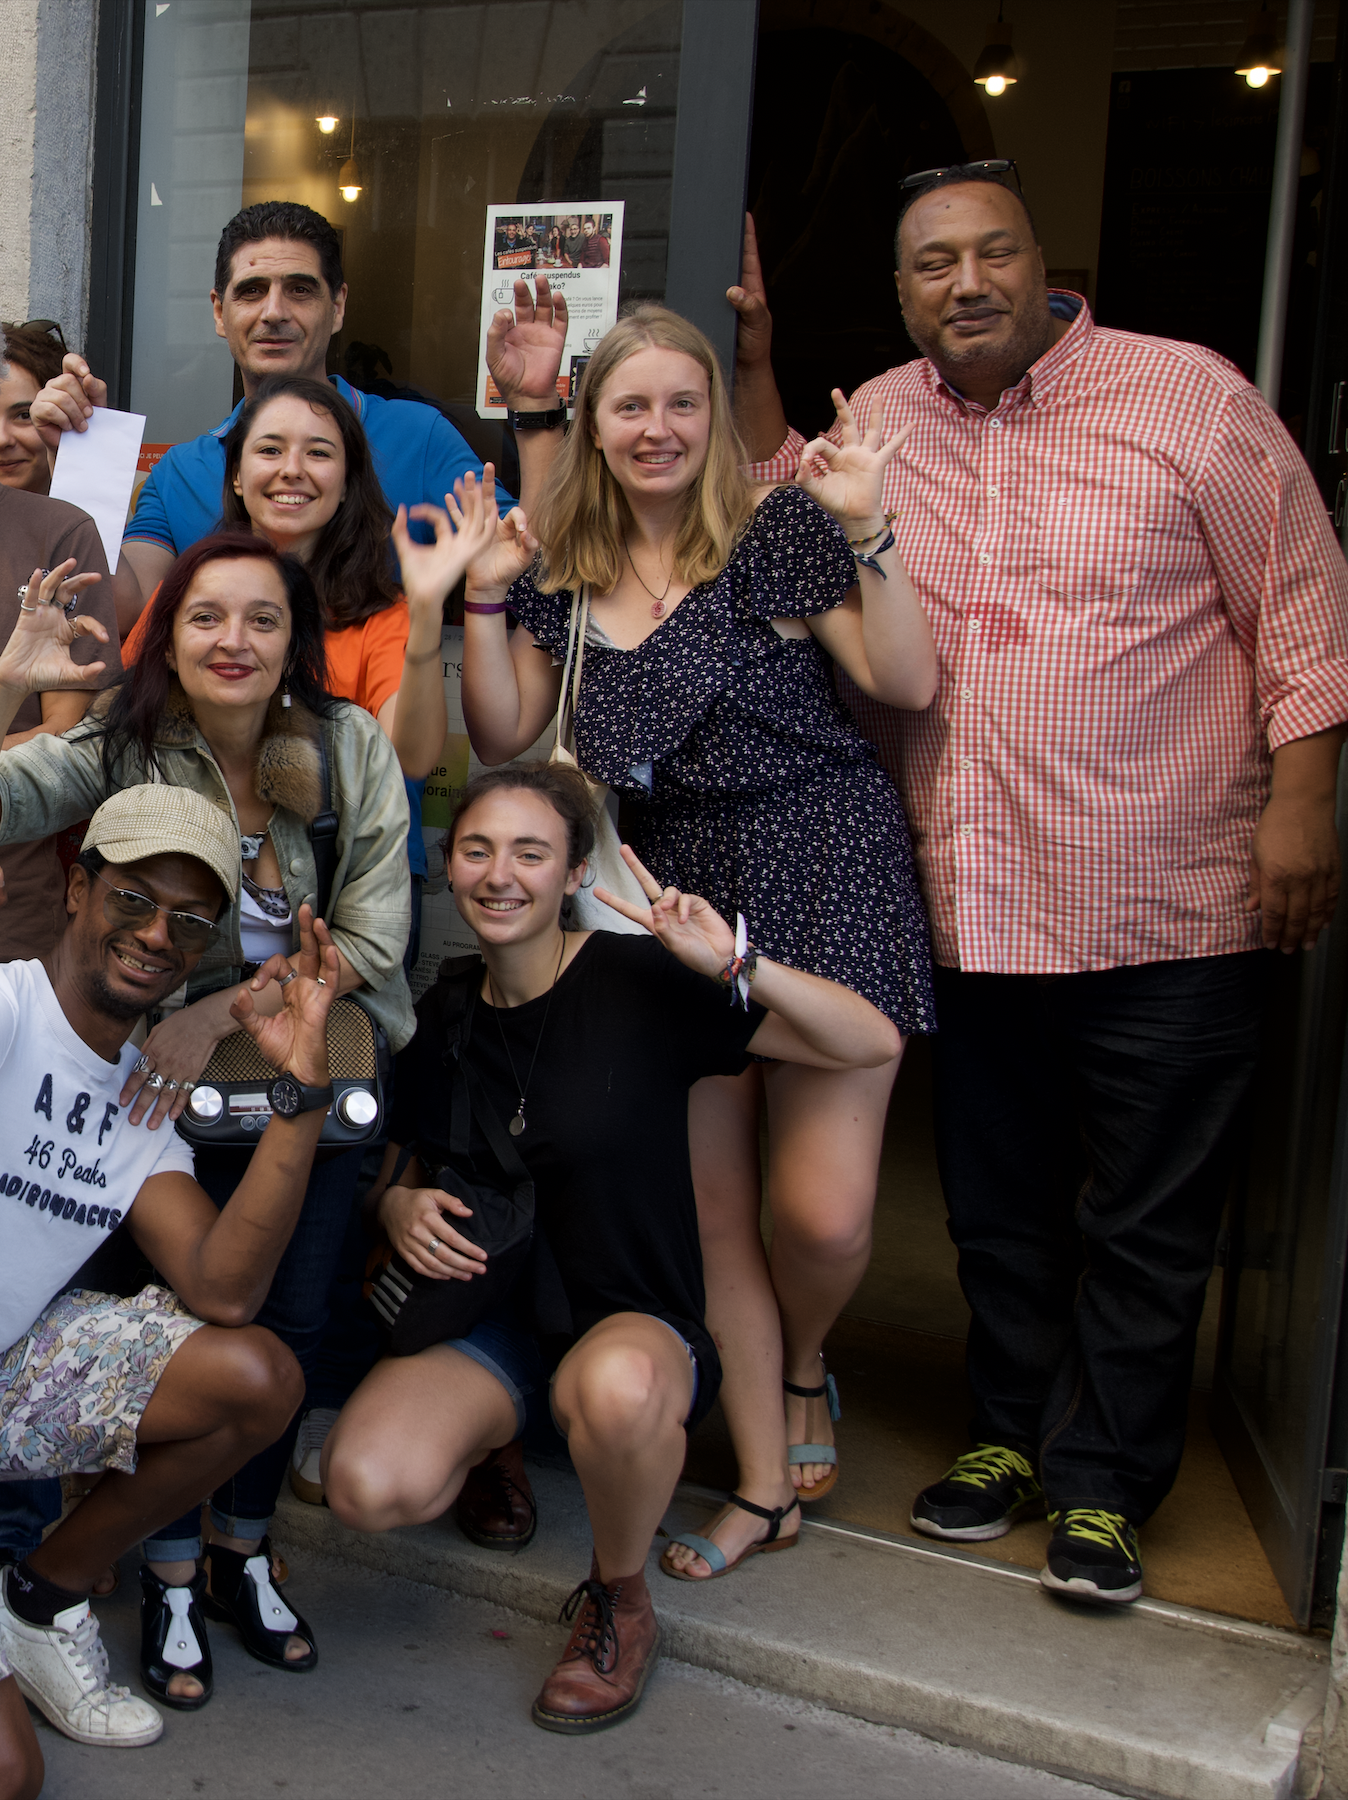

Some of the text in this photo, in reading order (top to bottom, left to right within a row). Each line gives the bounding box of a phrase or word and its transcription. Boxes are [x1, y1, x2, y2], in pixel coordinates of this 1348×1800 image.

[1229, 167, 1271, 187] CHAU
[520, 272, 539, 280] Café
[34, 1073, 52, 1121] A
[98, 1102, 119, 1146] F
[24, 1134, 107, 1188] 46 Peaks
